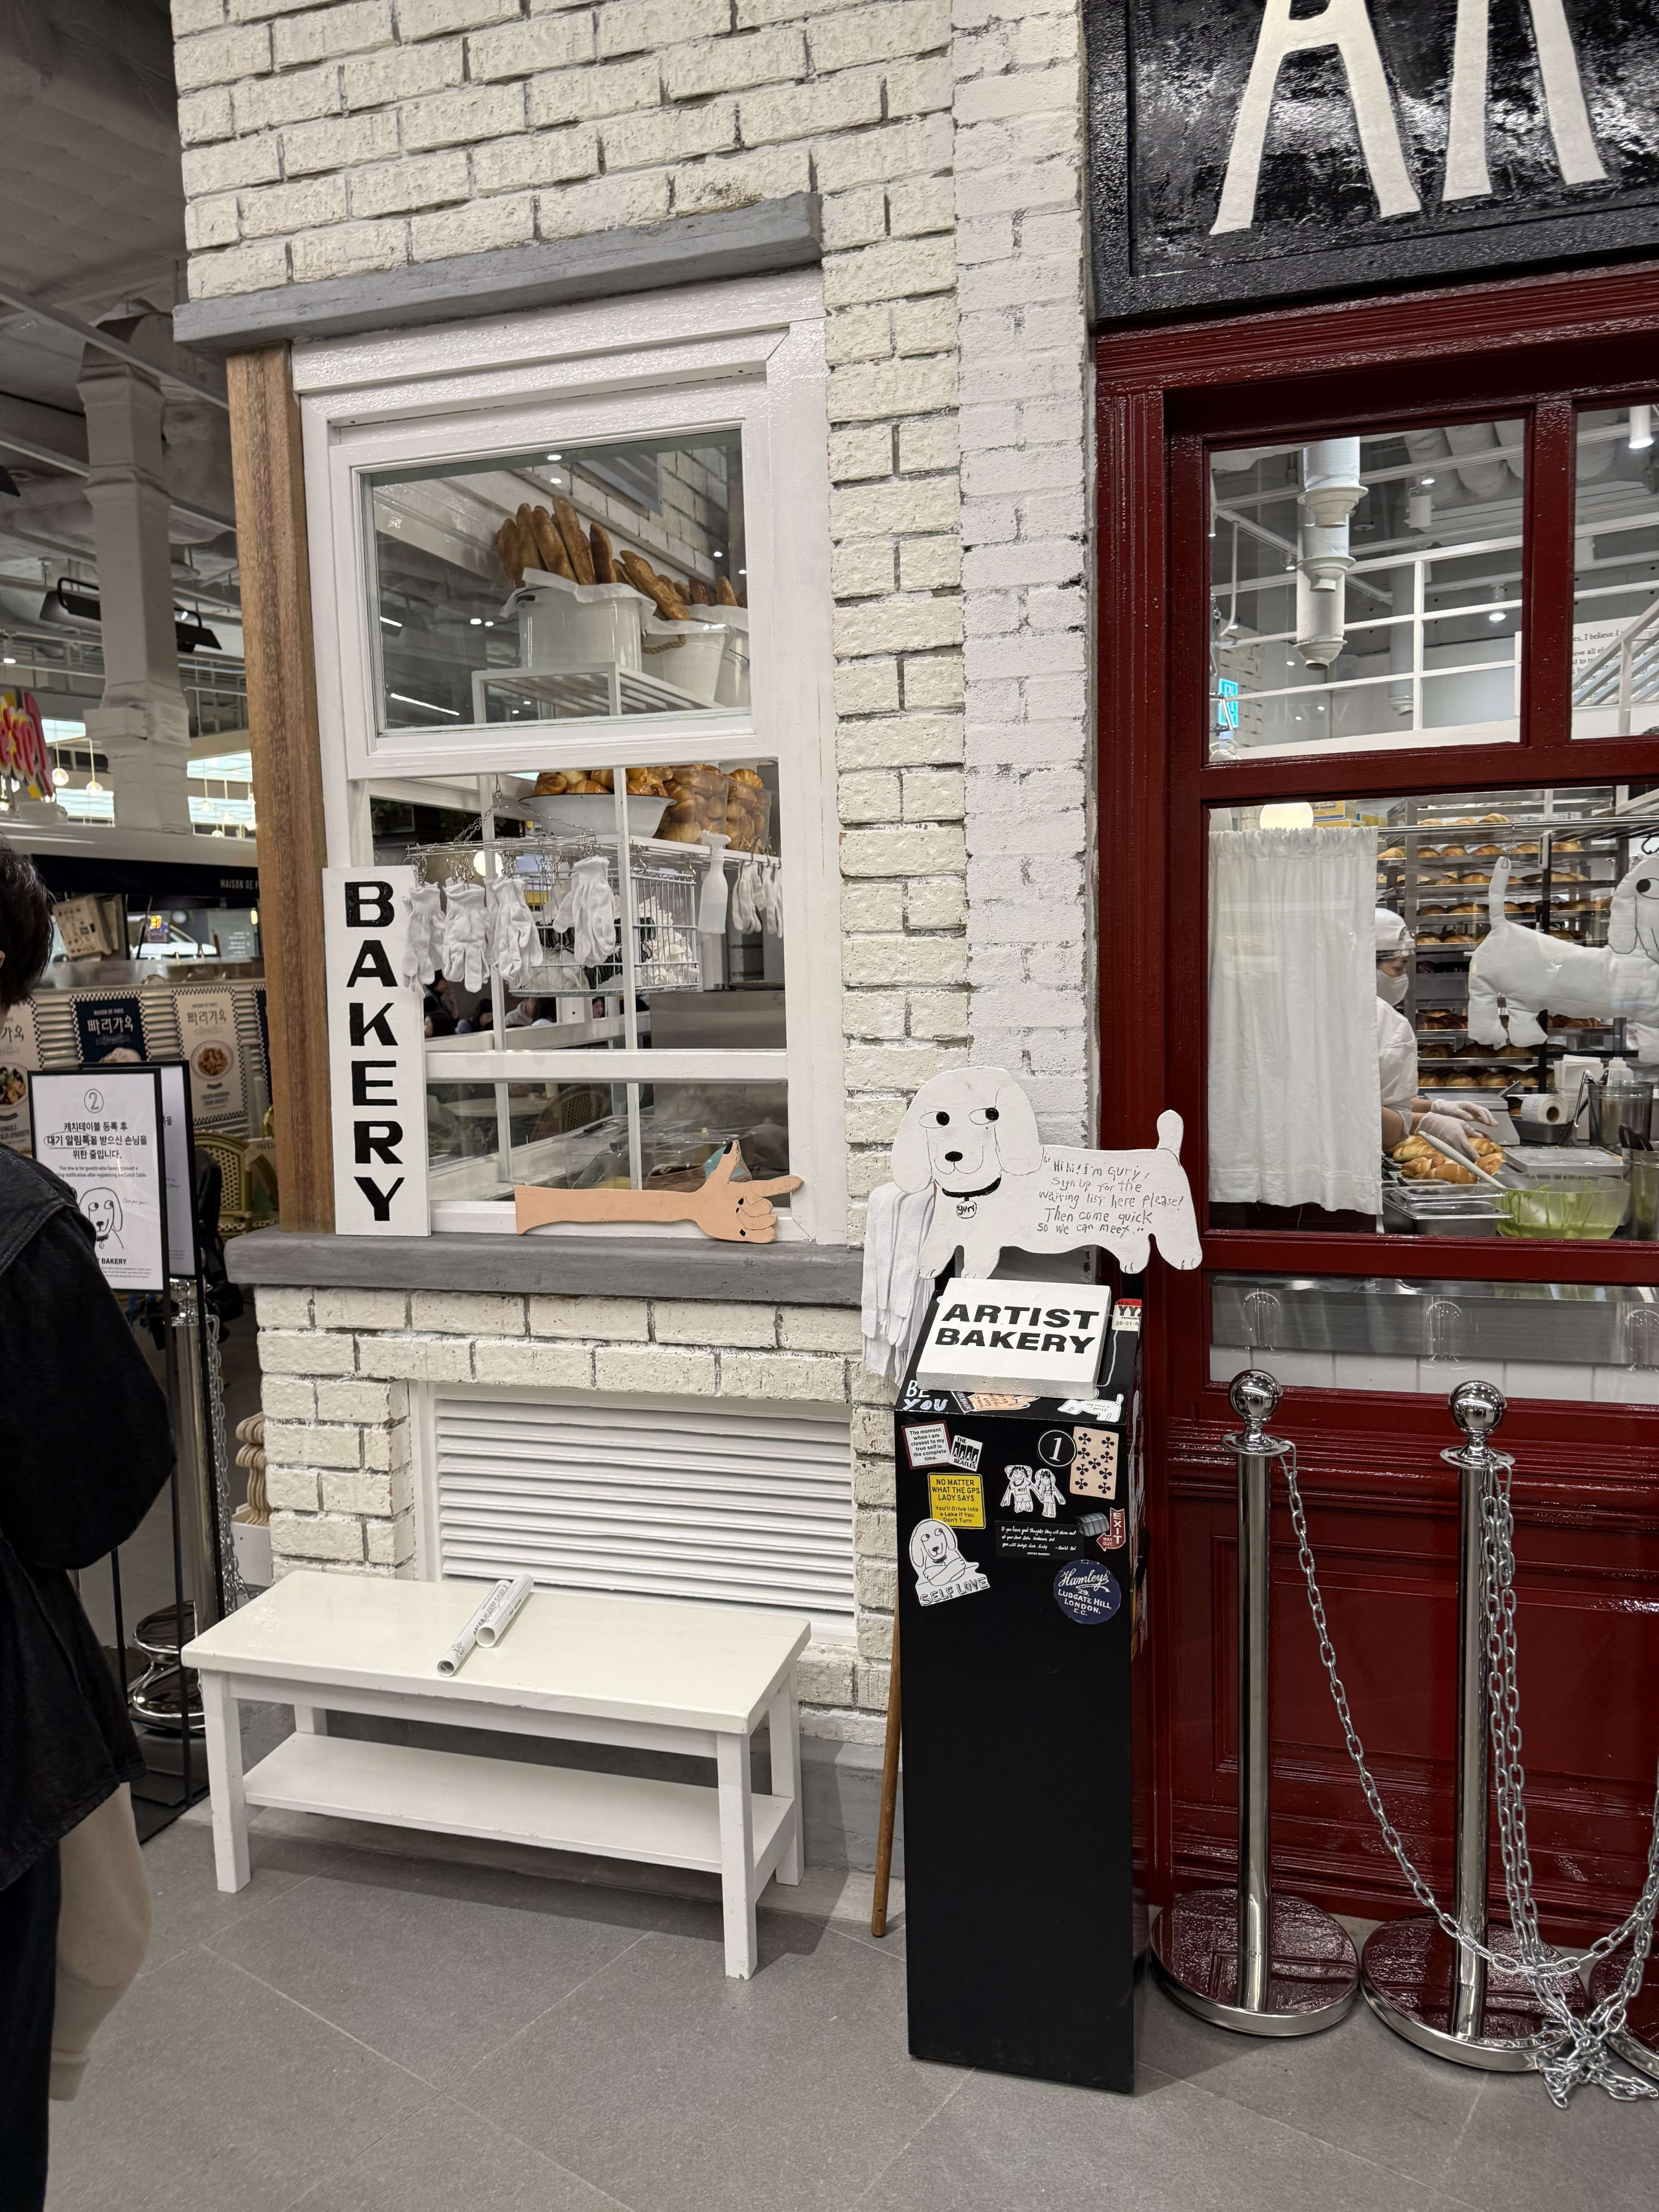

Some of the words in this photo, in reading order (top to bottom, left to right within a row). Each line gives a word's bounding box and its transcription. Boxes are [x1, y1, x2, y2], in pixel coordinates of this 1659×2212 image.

[220, 879, 243, 889] MAISON
[246, 881, 253, 889] DE
[87, 1015, 133, 1035] 빠리가옥
[187, 1009, 227, 1026] 빠리가옥
[345, 880, 405, 1222] BAKERY
[64, 1122, 100, 1132] 캐치테이블
[103, 1122, 117, 1131] 등록
[120, 1122, 128, 1131] 후
[47, 1135, 62, 1145] 대기
[100, 1135, 122, 1145] 받으신
[125, 1135, 147, 1145] 손님을
[73, 1150, 87, 1159] 위한
[1079, 1179, 1091, 1192] up
[1118, 1178, 1141, 1193] the
[1111, 1194, 1135, 1208] here
[1045, 1205, 1073, 1222] Then
[1079, 1211, 1109, 1222] come
[1118, 1209, 1153, 1225] quick
[1076, 1224, 1093, 1233] can
[941, 1303, 1099, 1329] ARTIST
[934, 1327, 1096, 1354] BAKERY
[903, 1399, 948, 1412] YOU
[954, 1458, 975, 1469] BEATLES
[1113, 1513, 1122, 1544] EXIT
[920, 1586, 954, 1606] SELF
[956, 1577, 988, 1594] LOVE
[1058, 1589, 1092, 1604] LUDGATE
[1093, 1598, 1112, 1610] HILL,
[1064, 1598, 1100, 1614] LONDON,
